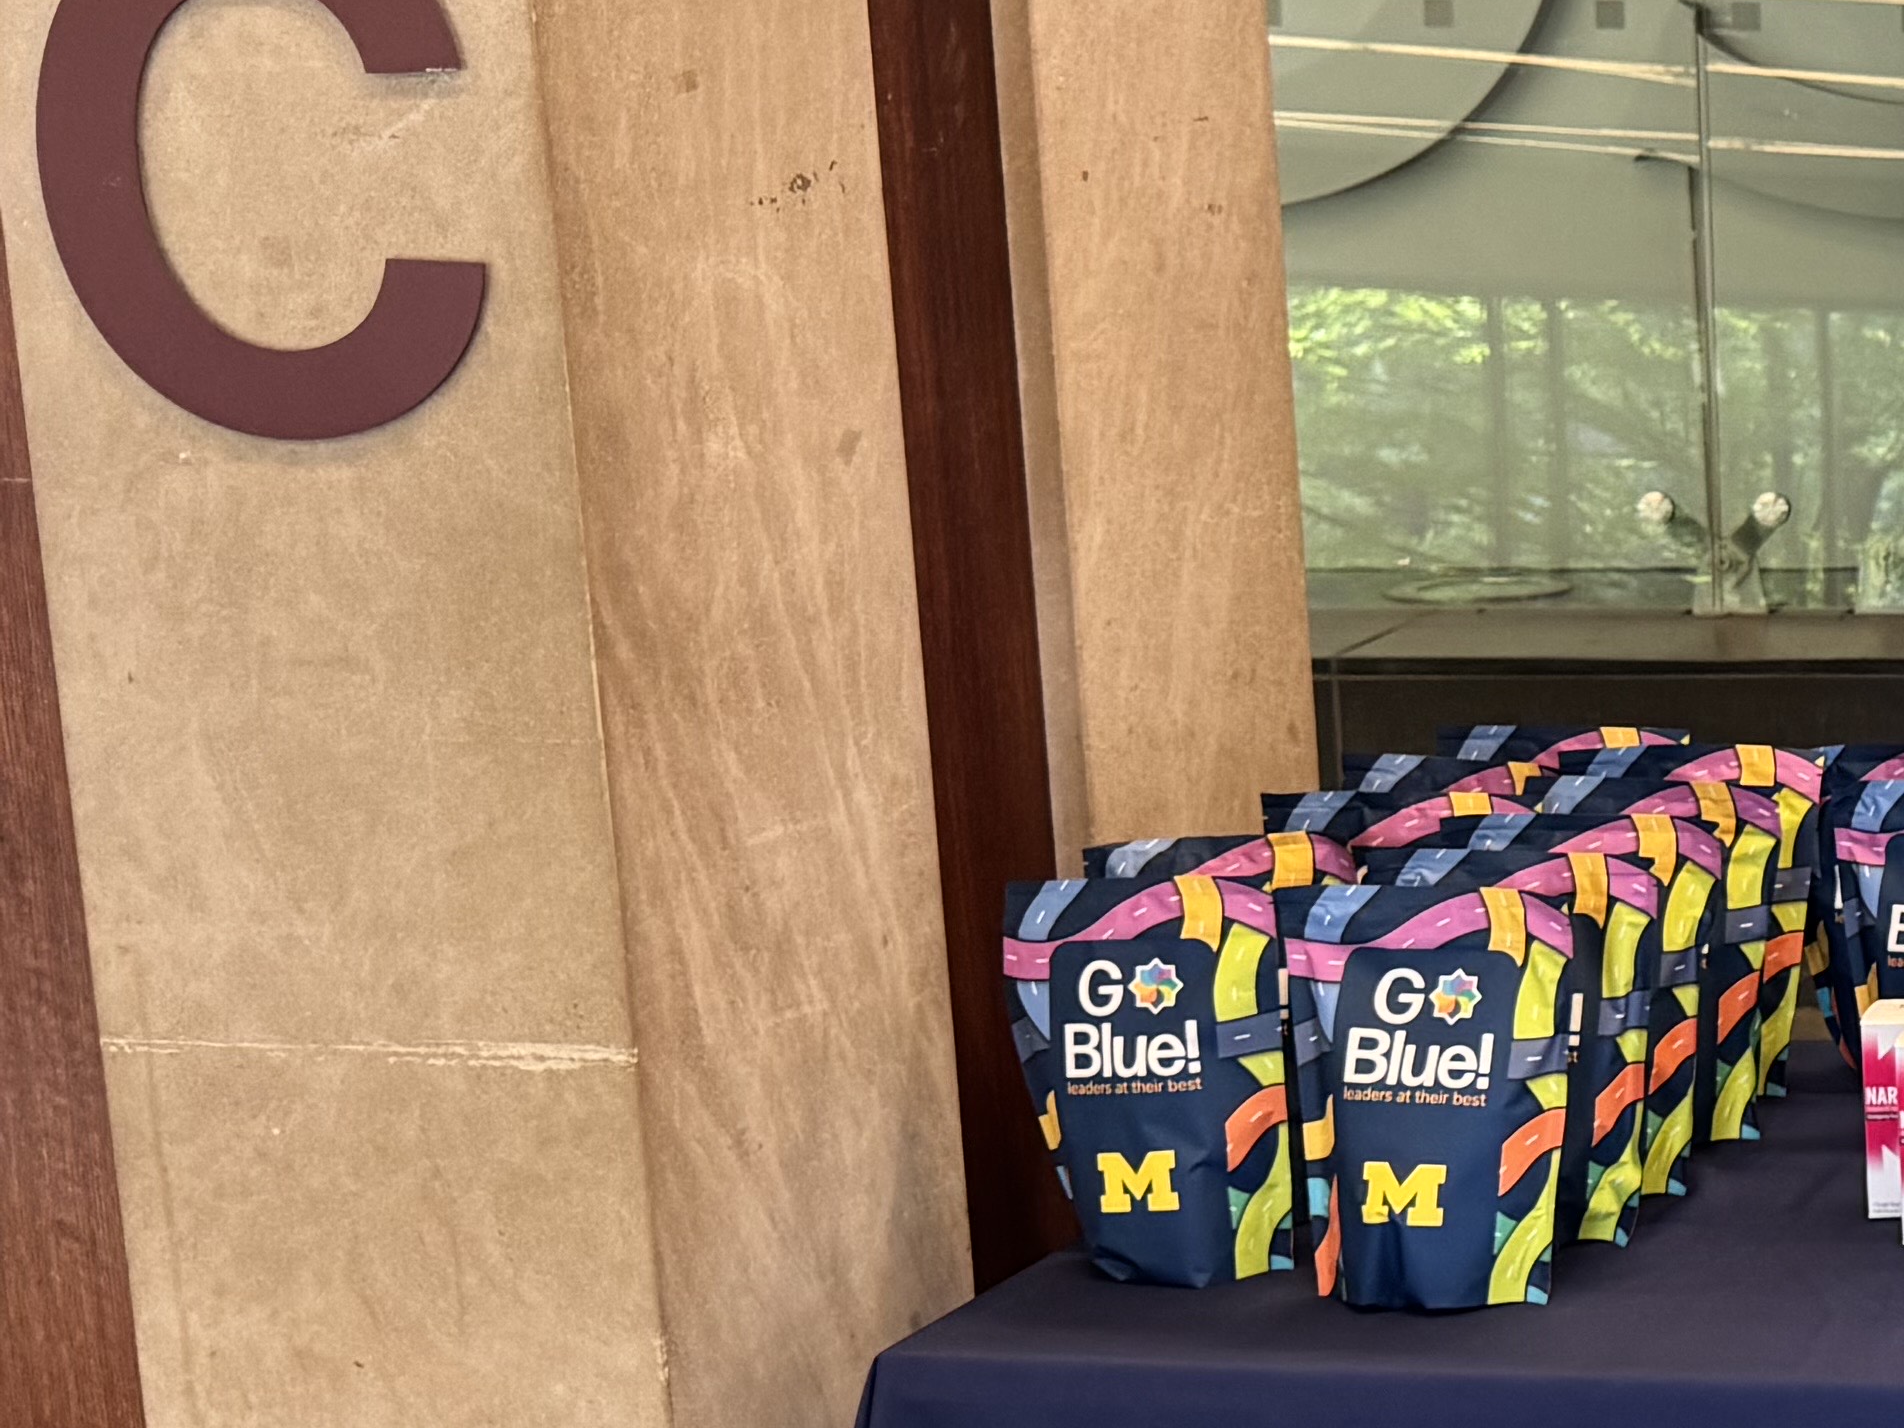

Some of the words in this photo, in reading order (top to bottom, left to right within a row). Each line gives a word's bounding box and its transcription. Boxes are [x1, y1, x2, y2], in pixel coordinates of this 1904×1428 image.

[1063, 1019, 1202, 1080] Blue!
[1342, 1027, 1495, 1089] Blue!
[1067, 1080, 1111, 1095] leaders
[1114, 1080, 1128, 1094] at
[1131, 1079, 1162, 1093] their
[1166, 1077, 1203, 1093] best
[1343, 1088, 1392, 1105] leaders
[1396, 1090, 1410, 1105] at
[1413, 1089, 1447, 1105] their
[1452, 1091, 1486, 1108] best
[1096, 1149, 1180, 1214] M
[1362, 1161, 1447, 1227] M
